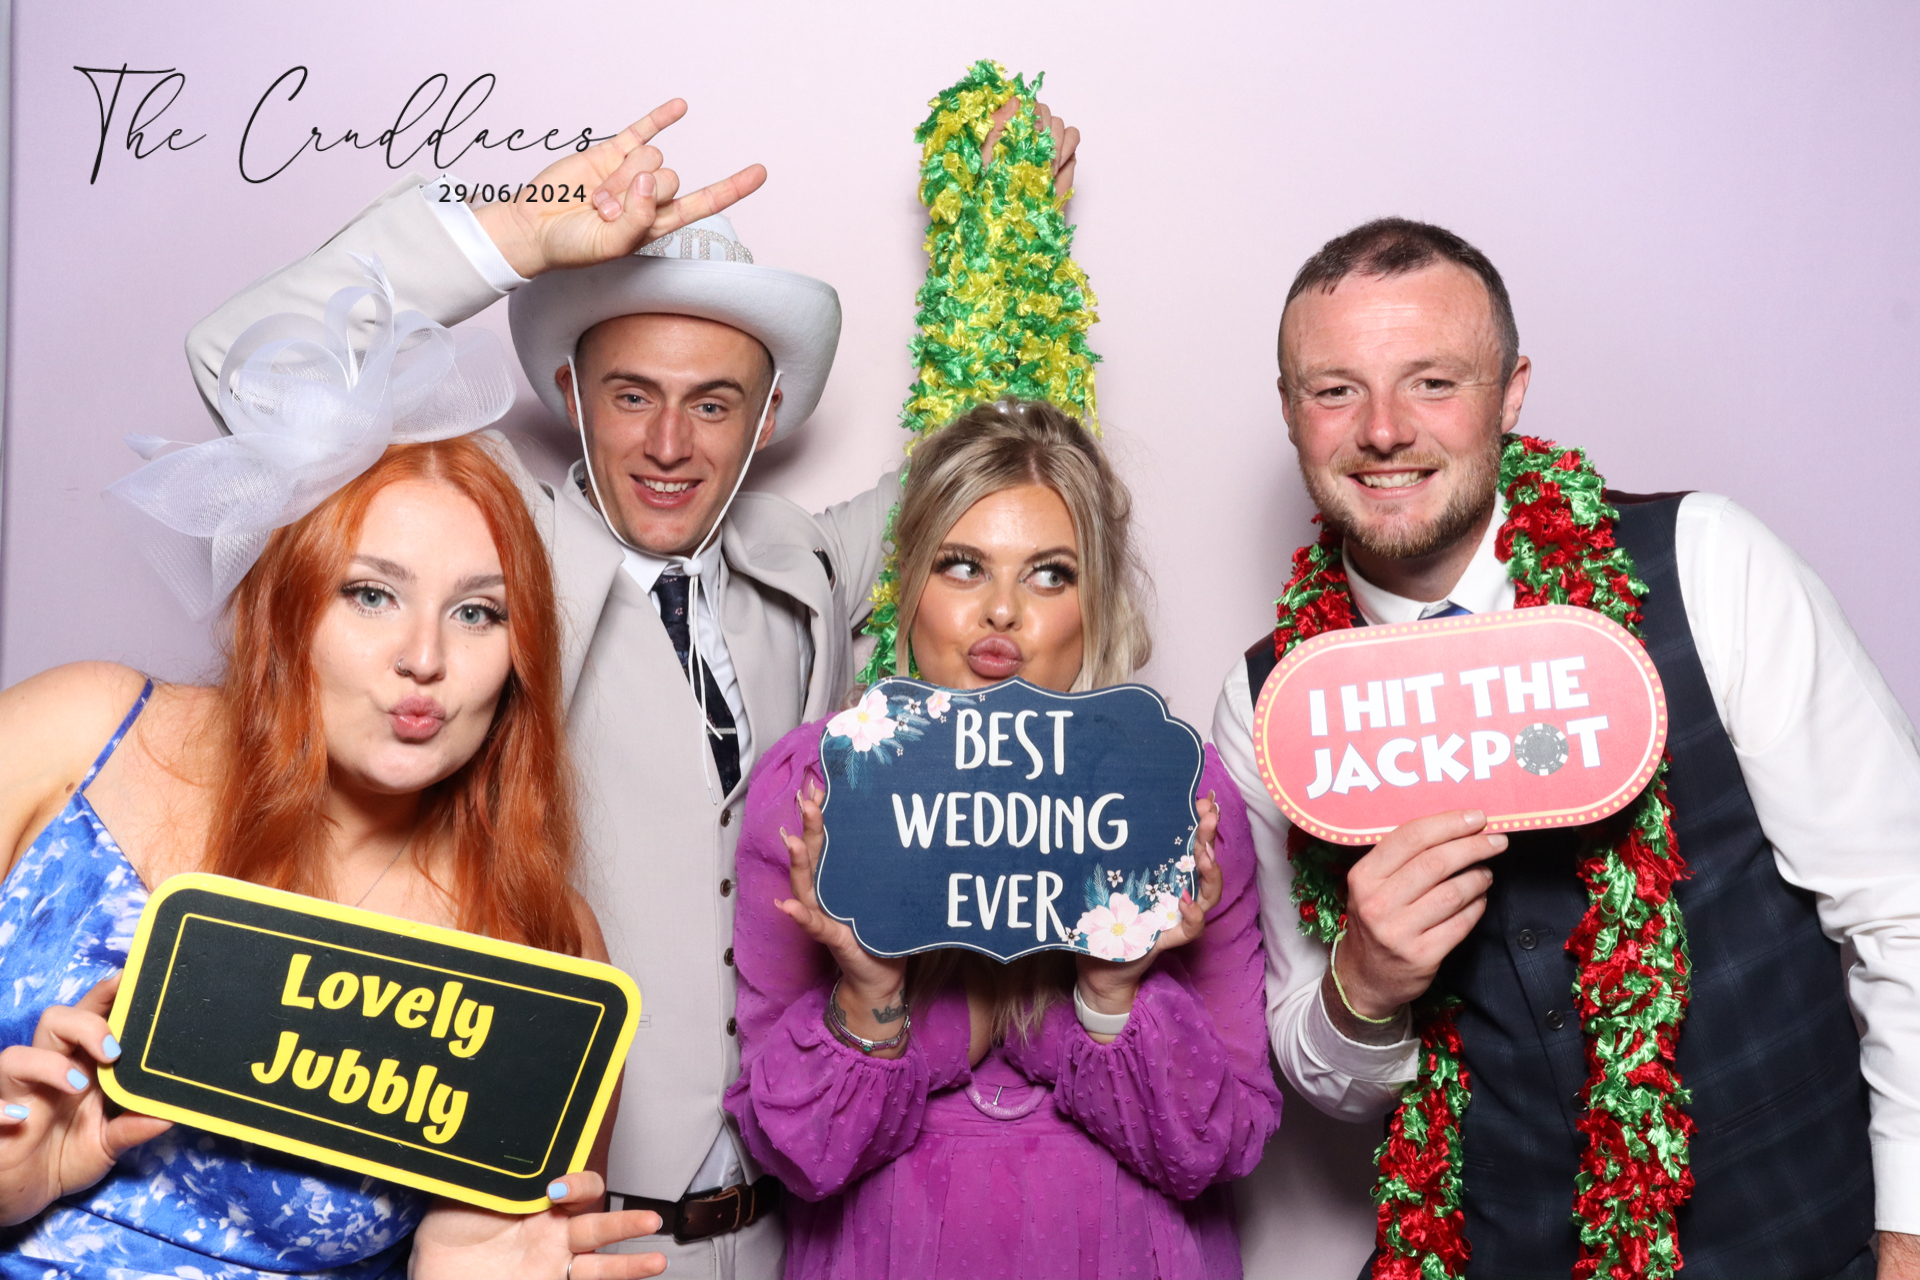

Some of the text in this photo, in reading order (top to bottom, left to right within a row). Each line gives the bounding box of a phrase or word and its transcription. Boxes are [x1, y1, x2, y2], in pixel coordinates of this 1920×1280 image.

[1308, 655, 1591, 738] I HIT THE
[954, 708, 1075, 781] BEST
[891, 791, 1129, 855] WEDDING
[946, 870, 1067, 943] EVER
[280, 953, 495, 1059] Lovely
[250, 1030, 469, 1145] Jubbly
